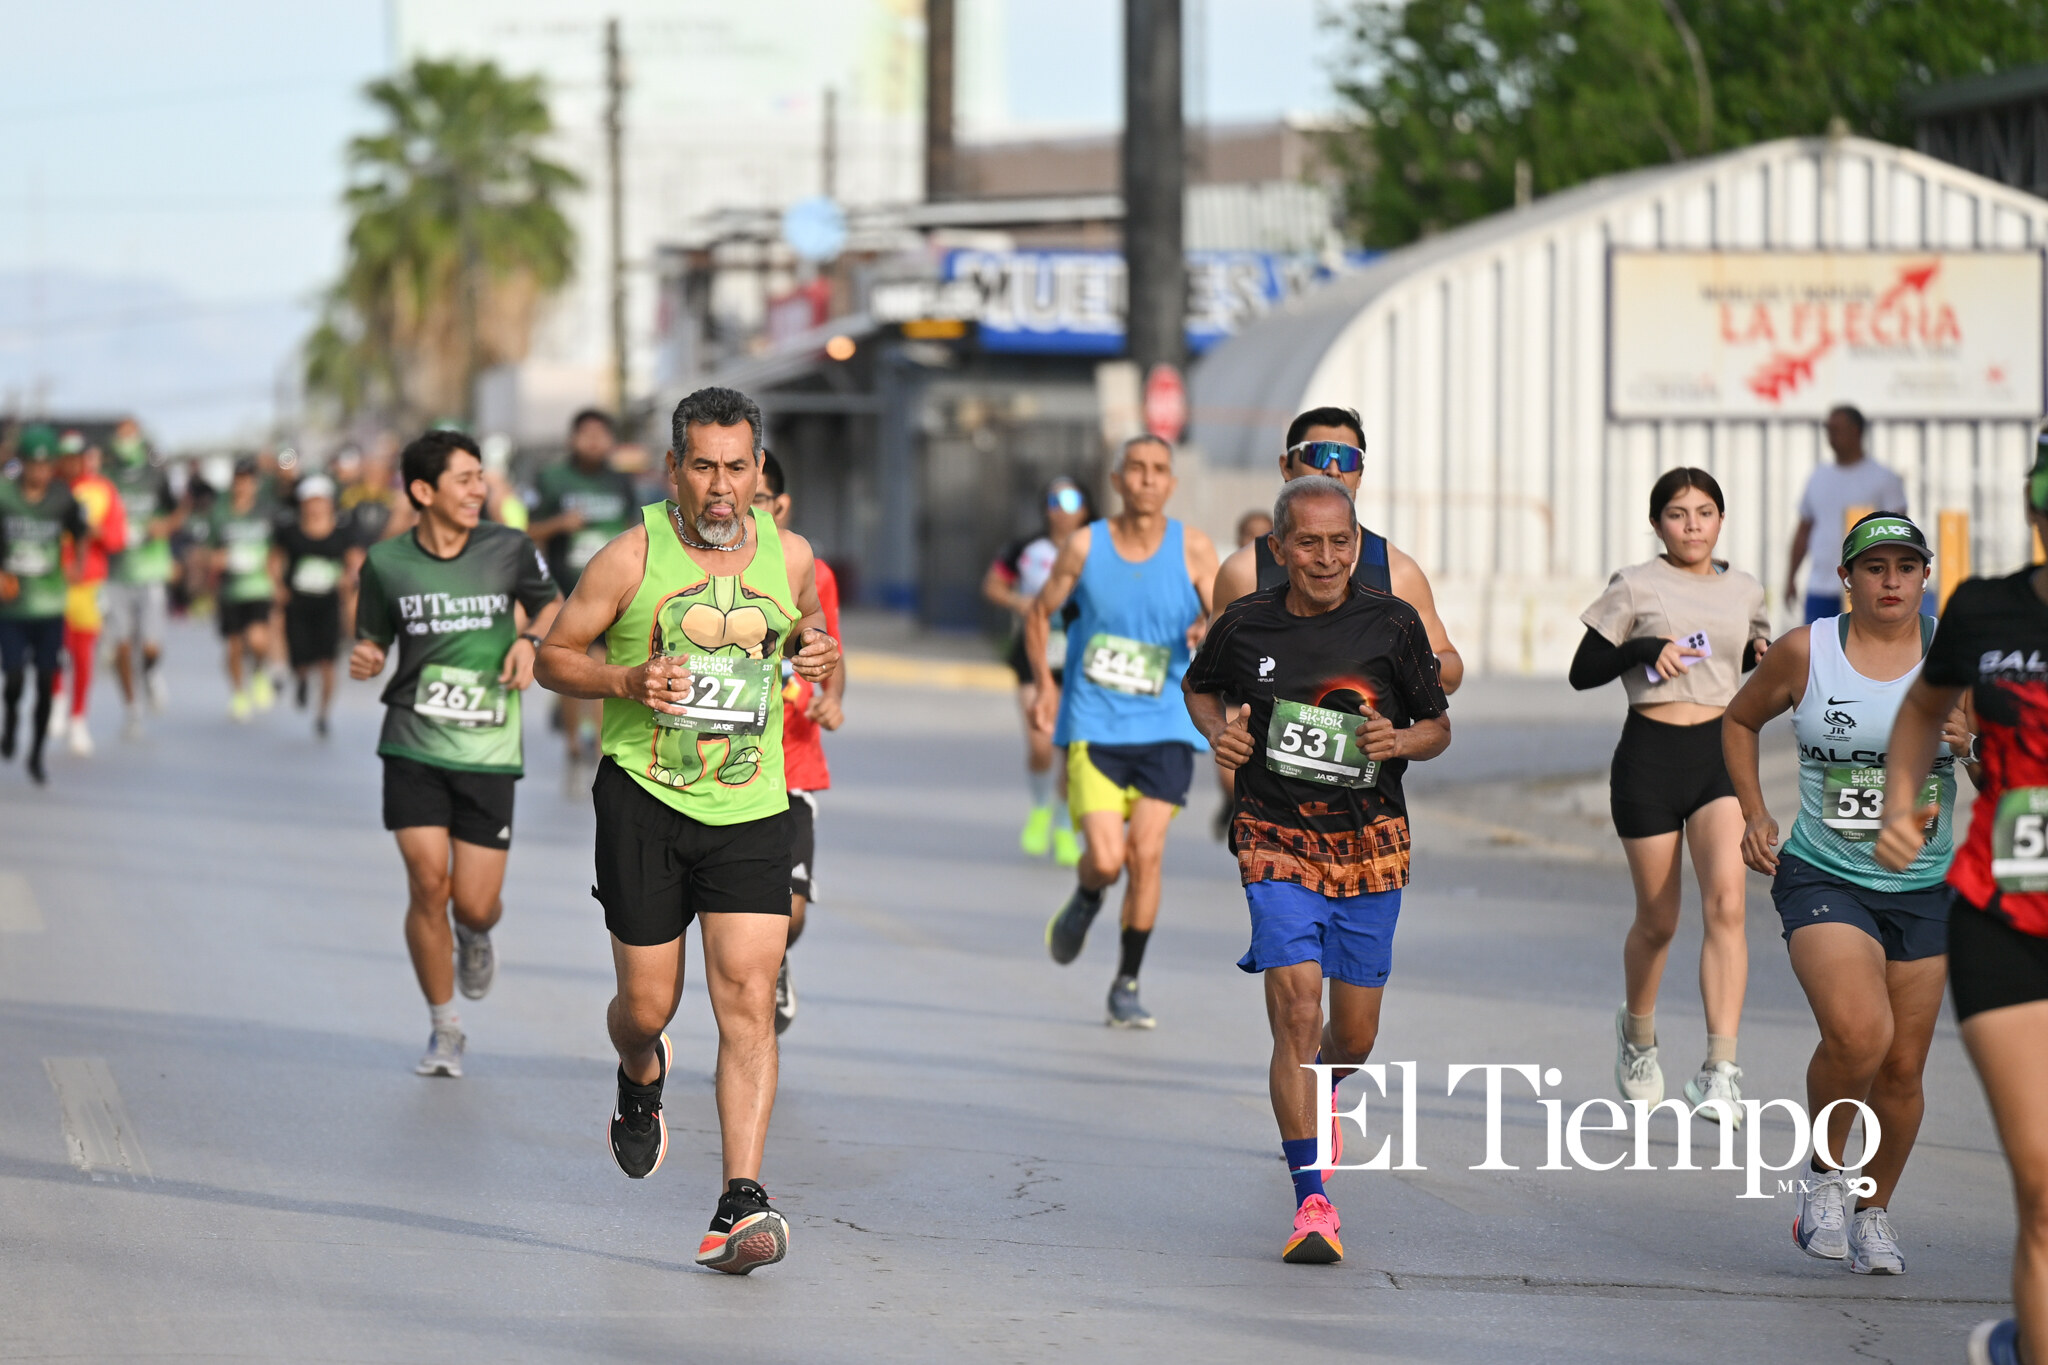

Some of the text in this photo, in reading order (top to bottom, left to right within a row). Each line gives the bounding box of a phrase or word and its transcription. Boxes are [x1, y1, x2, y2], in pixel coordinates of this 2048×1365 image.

[1718, 301, 1774, 344] LA
[400, 592, 508, 618] El Tiempo
[406, 615, 493, 635] de todos
[689, 655, 734, 664] CARRERA
[1092, 648, 1146, 677] 544
[427, 681, 486, 710] 267
[757, 676, 770, 726] MEDALLA
[1300, 705, 1344, 720] CARRERA
[1279, 722, 1347, 763] 531
[1830, 727, 1845, 735] JR
[1837, 788, 1884, 818] 53
[1925, 784, 1938, 829] MEALLA
[2013, 814, 2048, 858] 5
